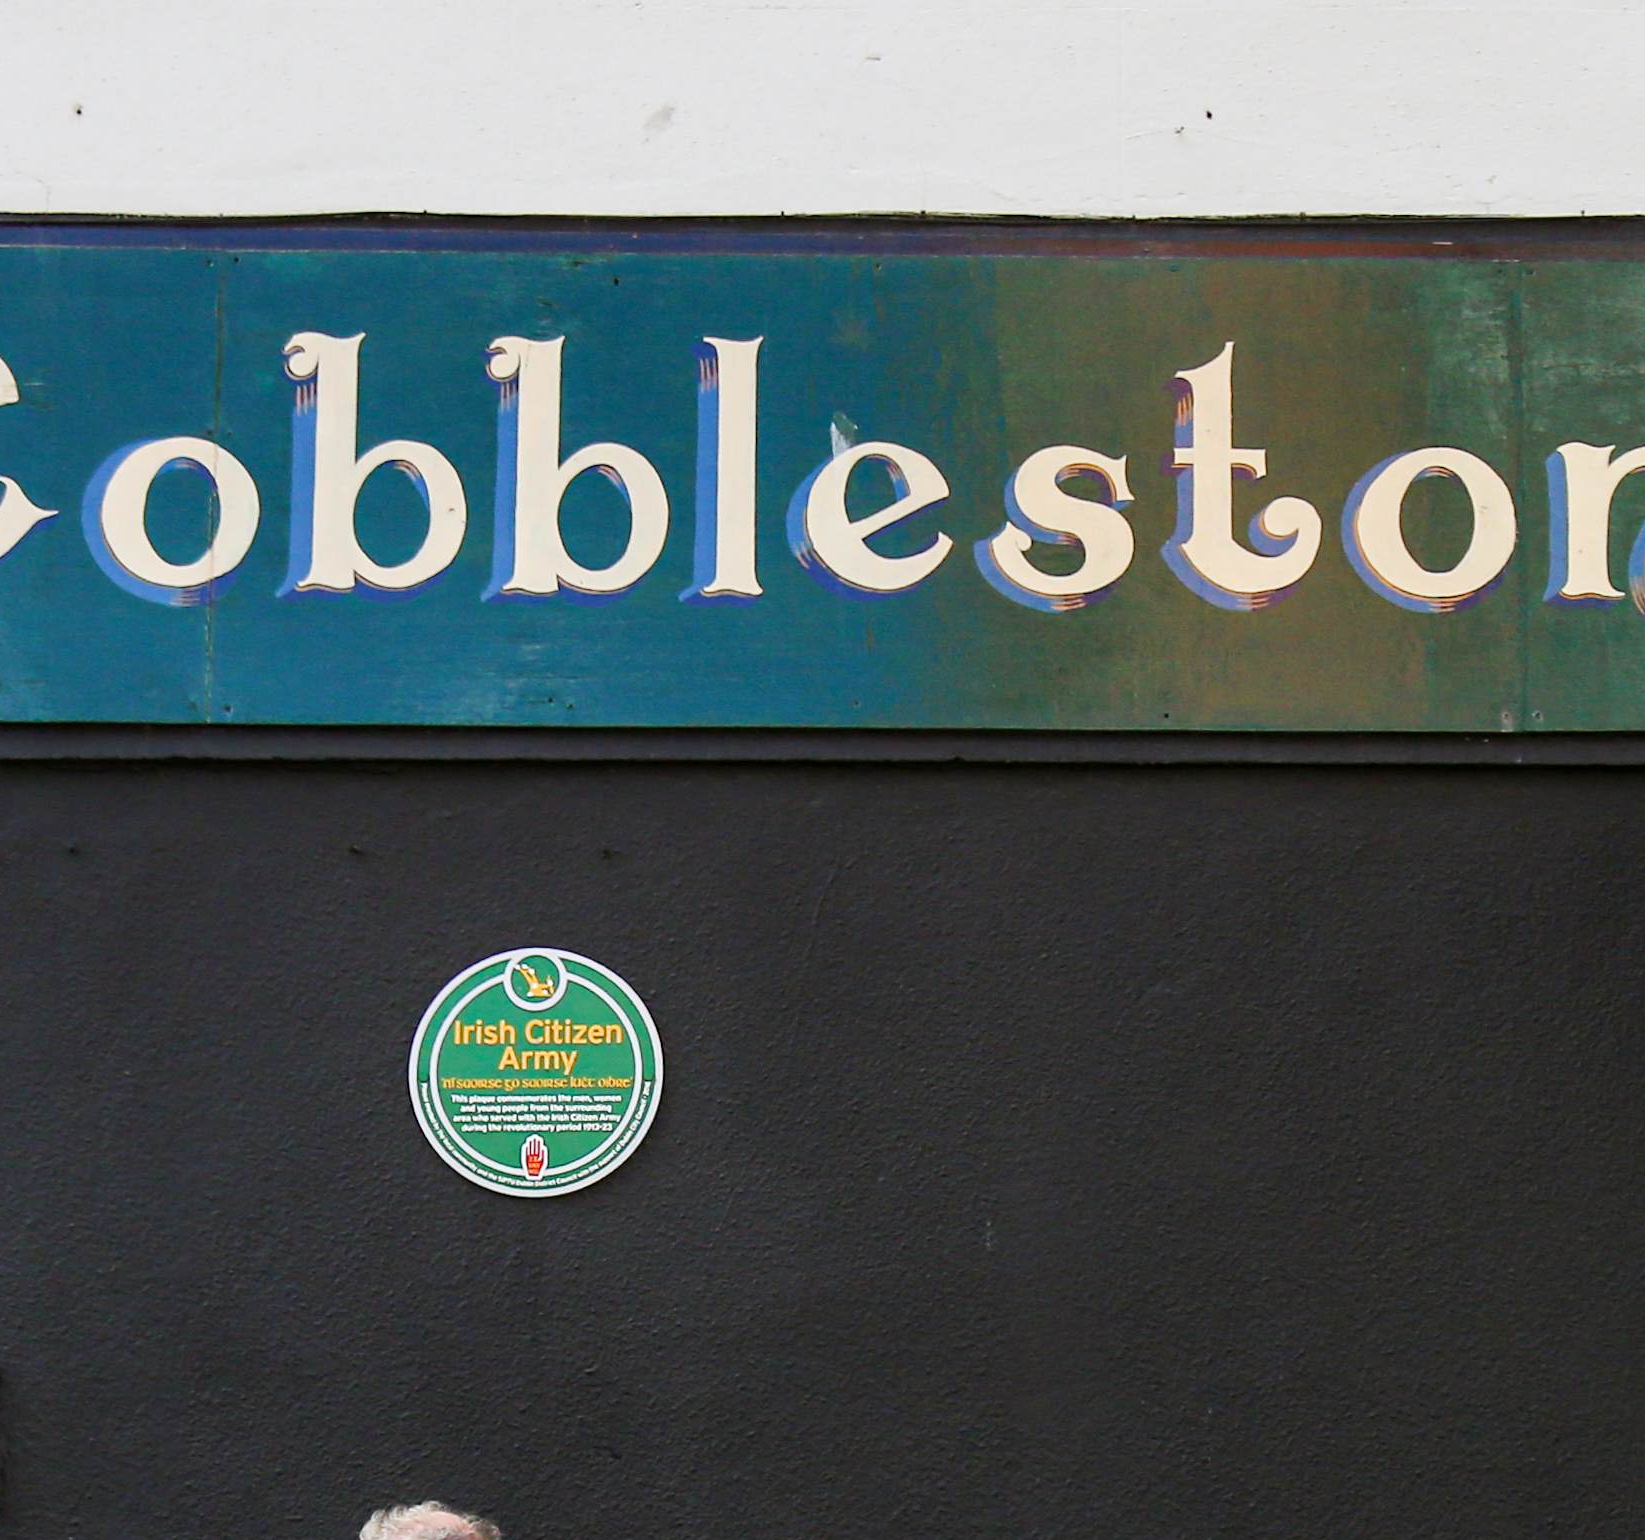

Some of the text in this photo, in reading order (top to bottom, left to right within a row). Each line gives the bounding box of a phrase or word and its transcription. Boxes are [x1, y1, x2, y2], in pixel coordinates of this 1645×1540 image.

[453, 1019, 623, 1045] Irish Citizen
[498, 1046, 578, 1076] Army
[451, 1094, 468, 1103] This
[469, 1094, 496, 1104] plaque
[557, 1094, 571, 1102] the
[460, 1104, 612, 1114] and young people from the surrounding
[472, 1114, 489, 1122] who
[490, 1114, 517, 1122] served
[570, 1113, 598, 1122] Citizen
[599, 1113, 621, 1123] Army
[461, 1123, 487, 1133] during
[488, 1123, 502, 1132] the
[503, 1123, 555, 1132] revolutionary
[556, 1123, 582, 1132] period
